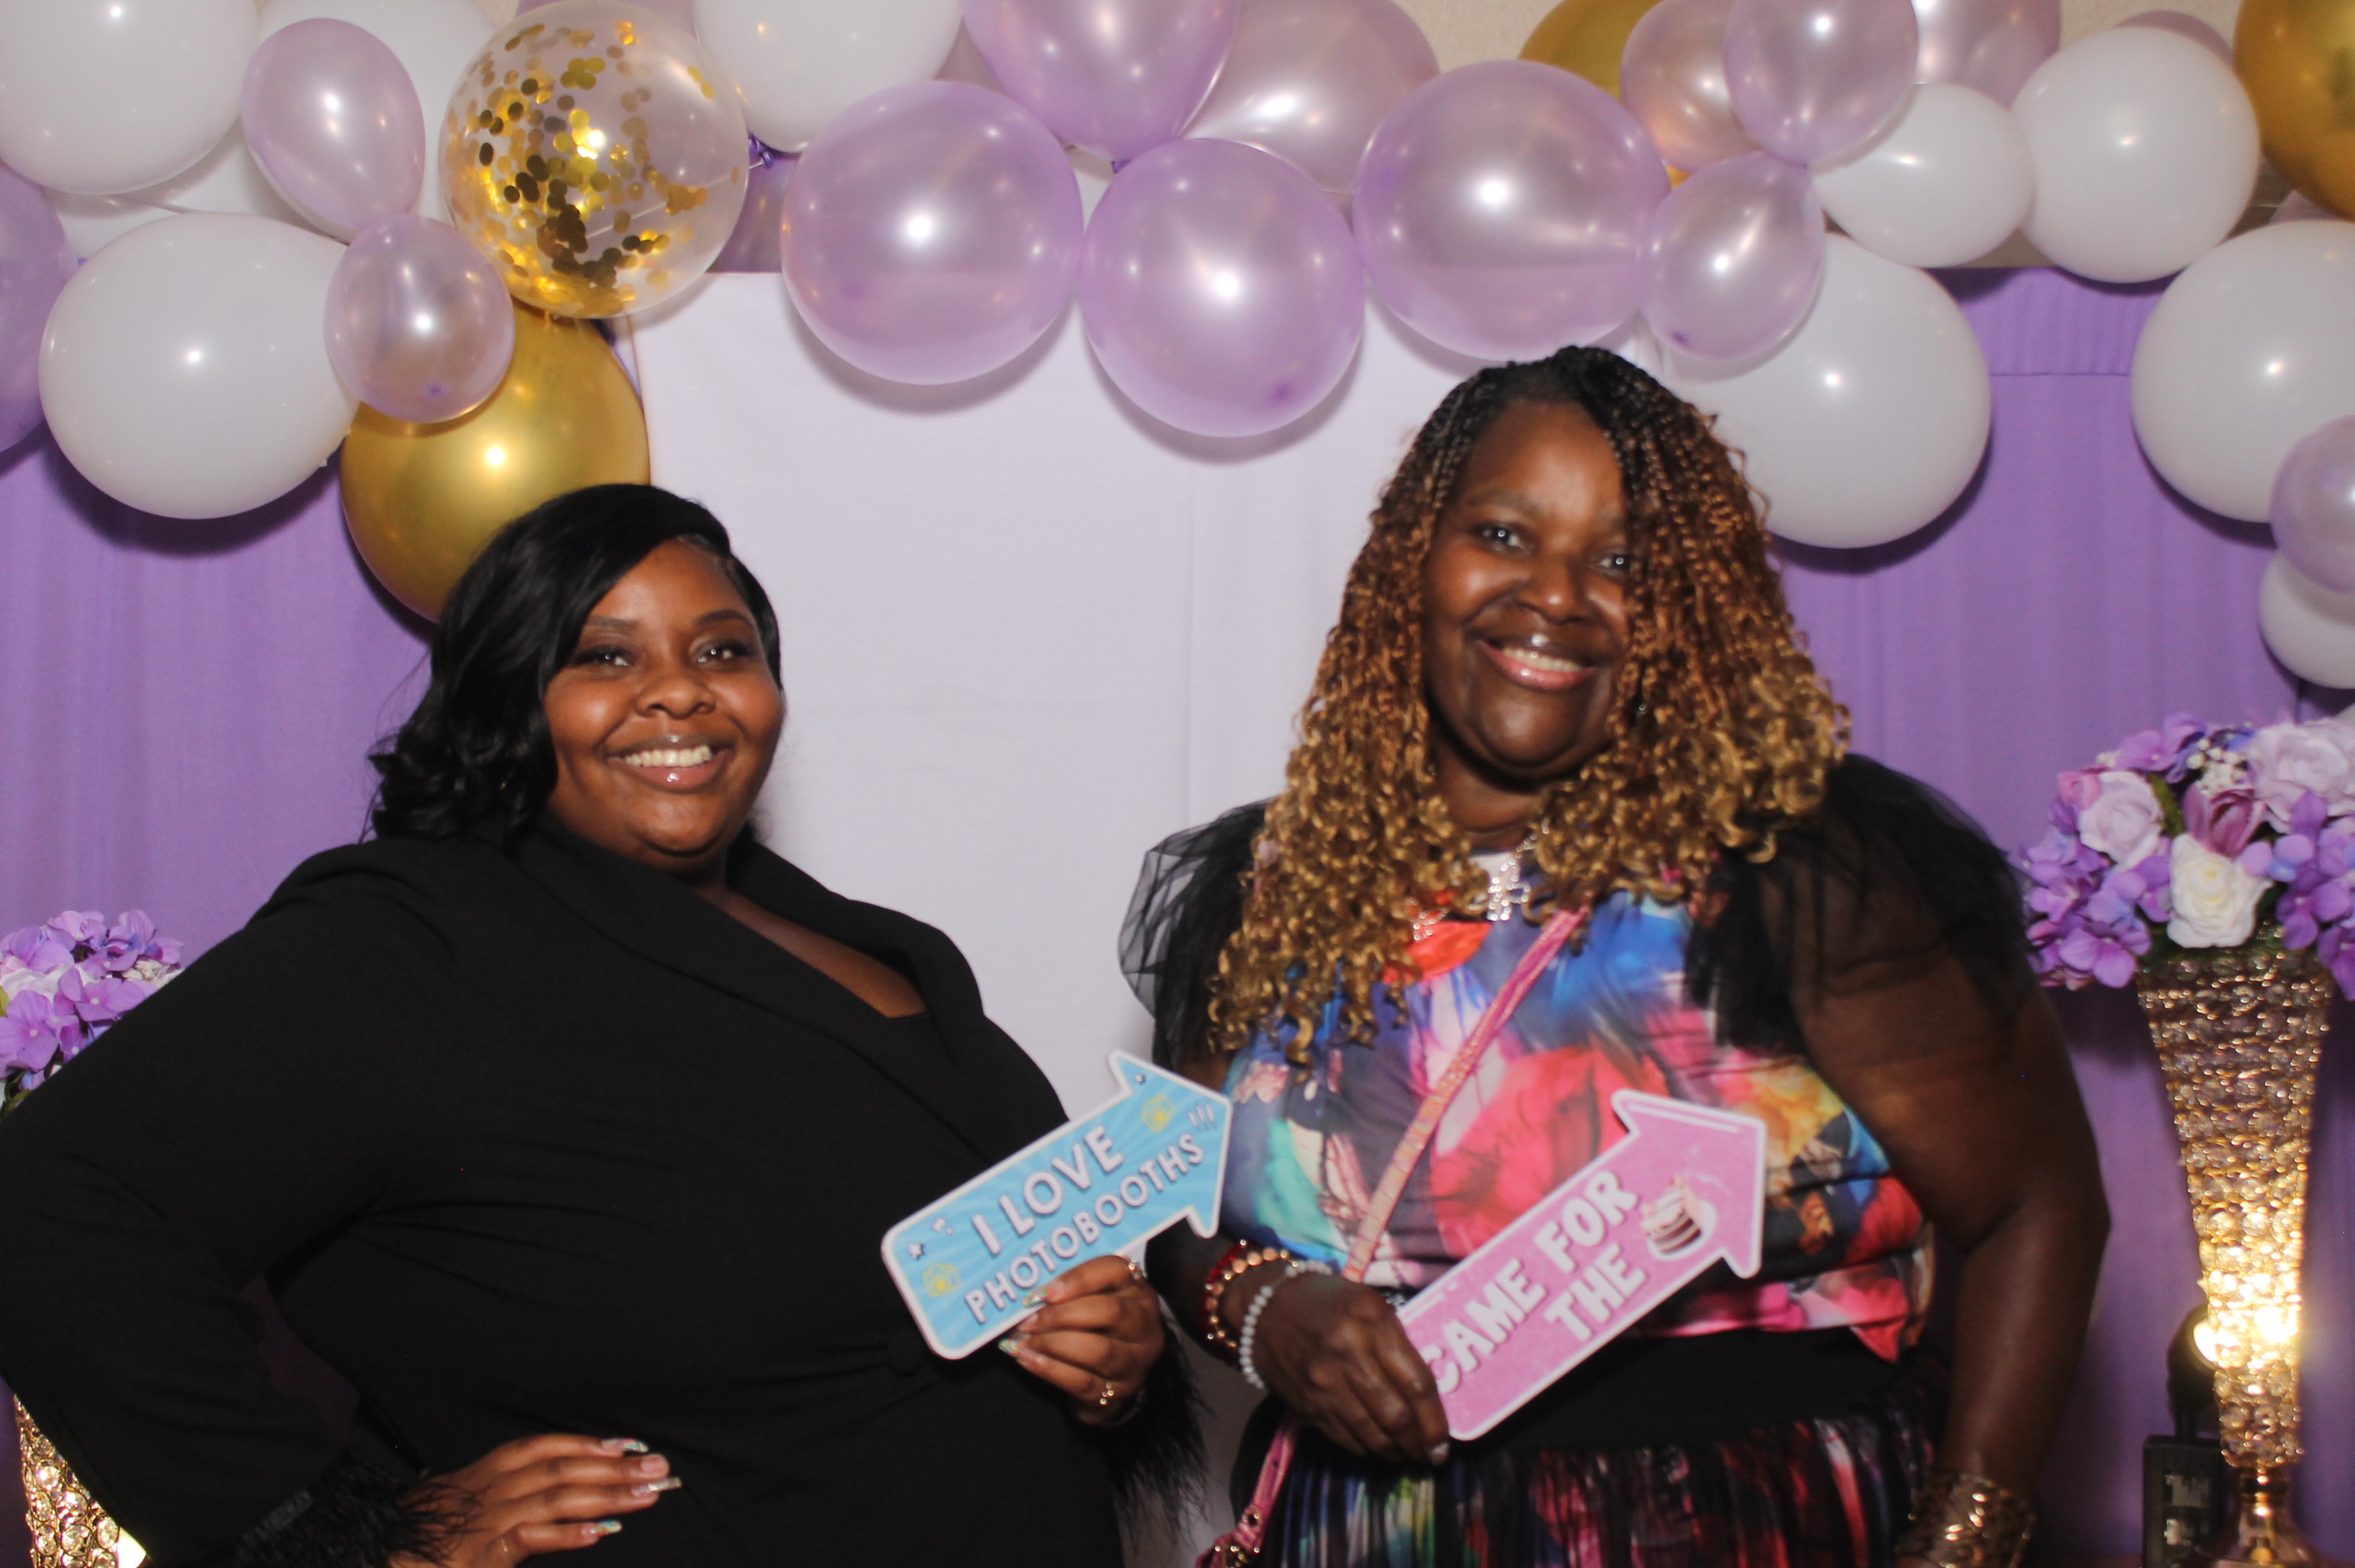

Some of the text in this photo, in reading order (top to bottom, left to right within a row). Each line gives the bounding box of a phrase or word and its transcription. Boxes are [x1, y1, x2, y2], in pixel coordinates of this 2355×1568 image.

[964, 1133, 1204, 1324] PHOTOBOOTHS
[972, 1125, 1124, 1255] I LOVE
[1533, 1170, 1638, 1274] FOR
[1544, 1242, 1647, 1342] THE
